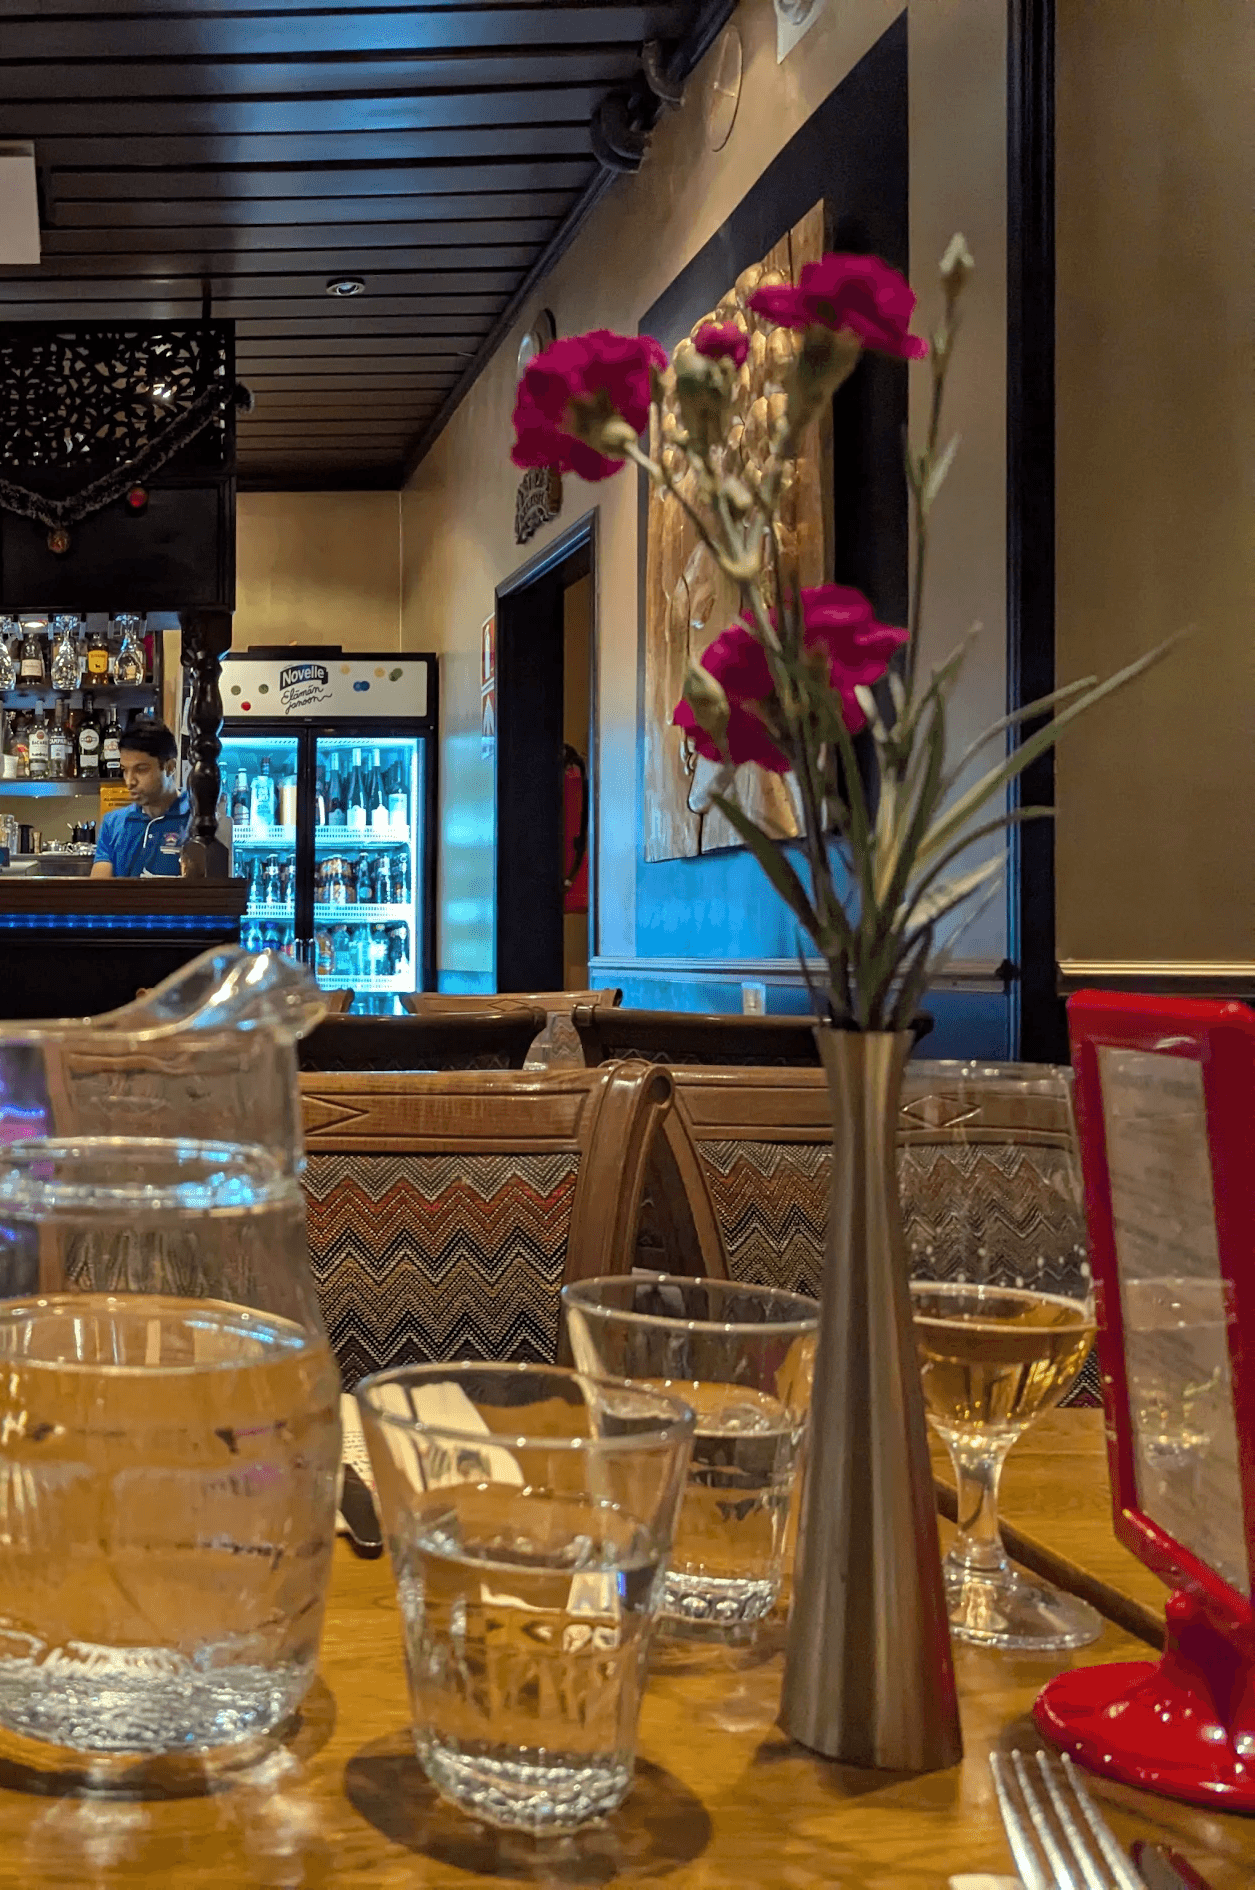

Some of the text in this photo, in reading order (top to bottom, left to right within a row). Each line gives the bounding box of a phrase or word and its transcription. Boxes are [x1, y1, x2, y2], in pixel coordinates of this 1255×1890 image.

[282, 665, 325, 688] Novelle
[280, 684, 325, 705] Elämän
[285, 692, 333, 715] janoon
